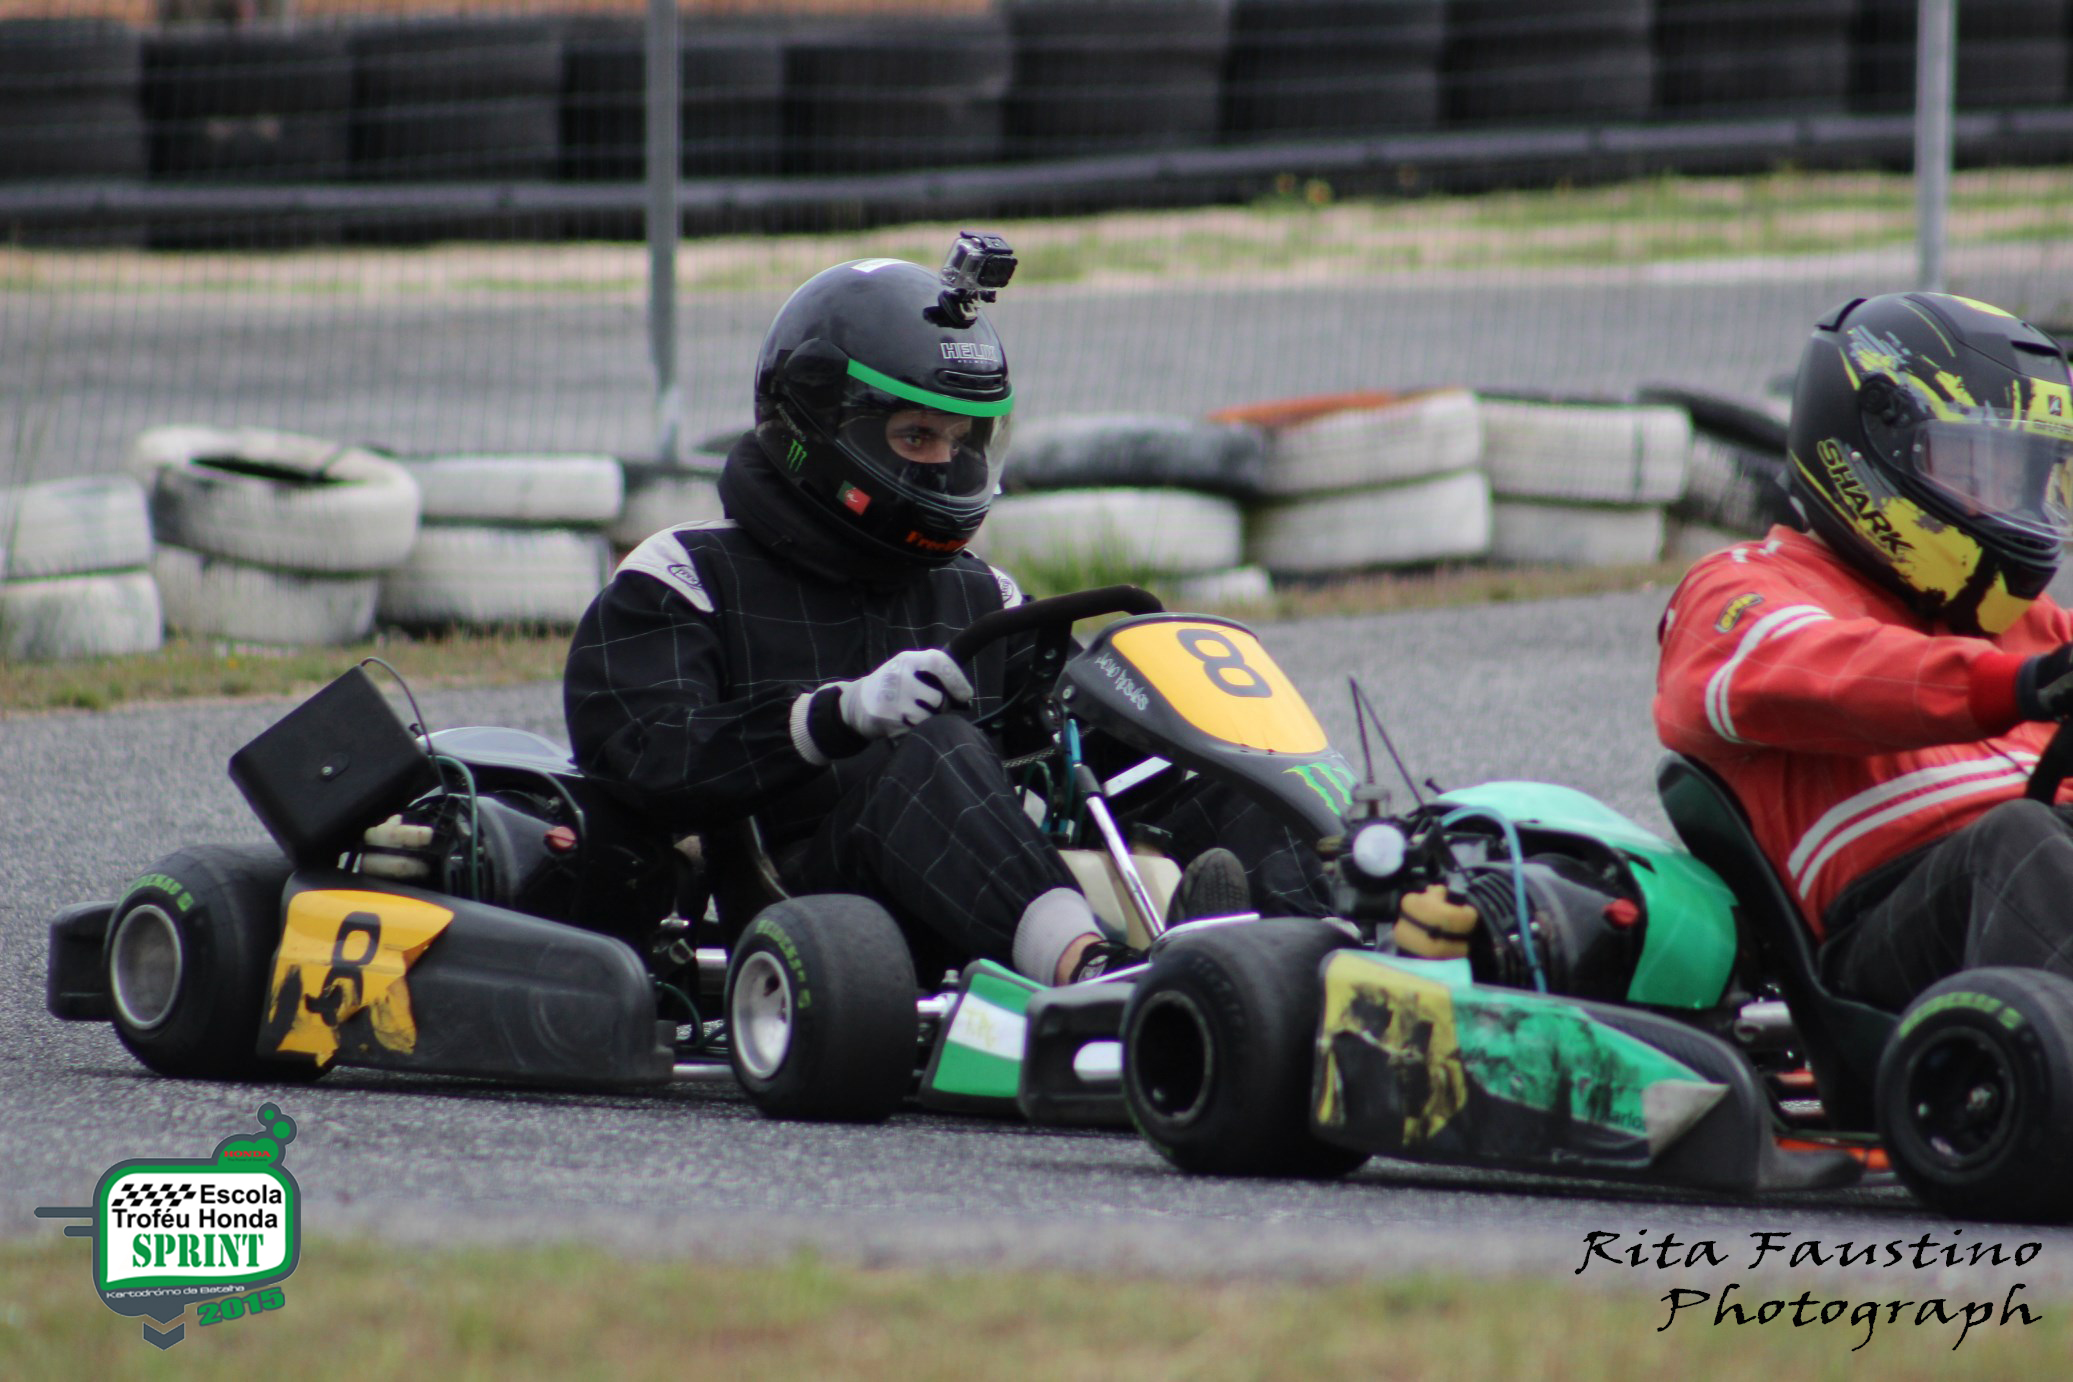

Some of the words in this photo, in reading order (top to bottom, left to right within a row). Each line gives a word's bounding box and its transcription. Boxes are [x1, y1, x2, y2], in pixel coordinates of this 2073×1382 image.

[940, 342, 998, 361] HELIX
[1817, 437, 1916, 554] SHARK
[1176, 628, 1273, 698] 8
[320, 910, 382, 1015] 8
